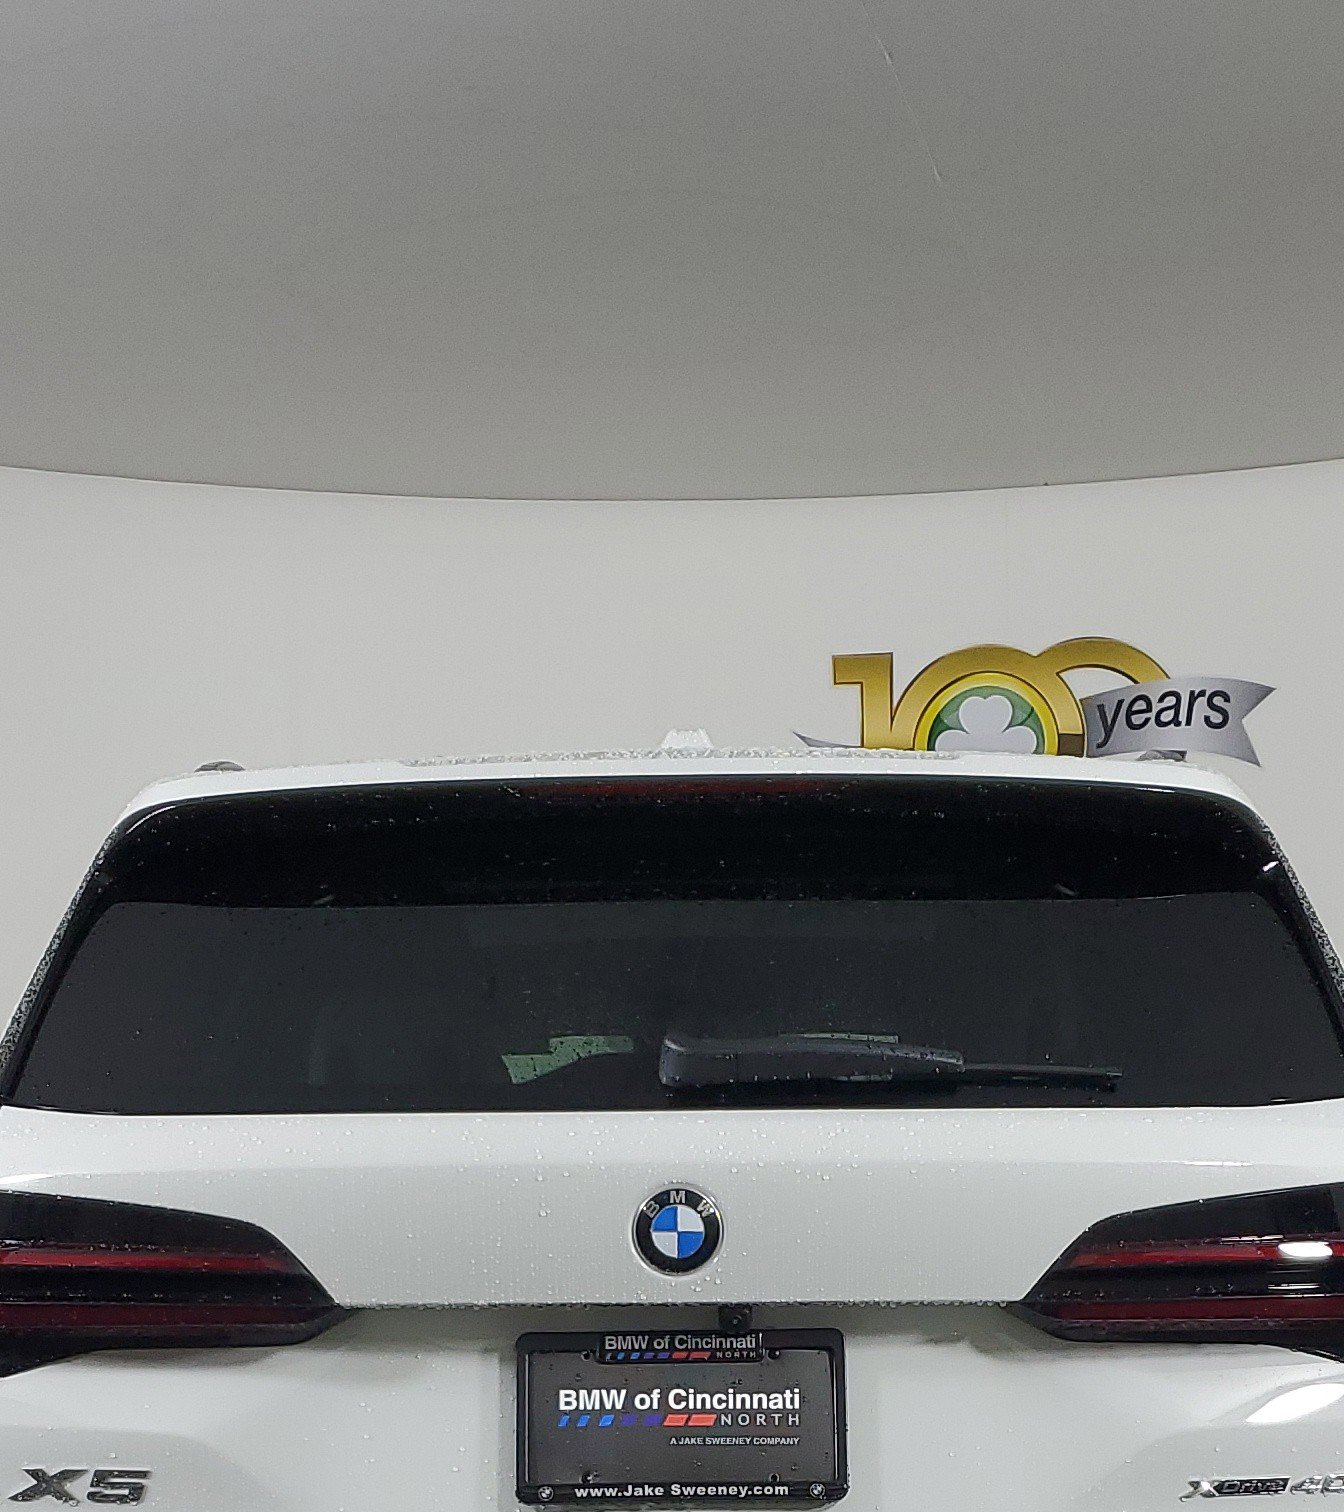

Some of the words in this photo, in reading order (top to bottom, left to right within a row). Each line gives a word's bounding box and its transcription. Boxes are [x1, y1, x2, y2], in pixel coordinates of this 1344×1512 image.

[1096, 686, 1231, 749] years
[643, 1190, 714, 1219] BMW
[605, 1335, 649, 1350] BMW
[653, 1335, 671, 1350] of
[674, 1334, 756, 1349] Cincinnati
[716, 1351, 757, 1359] NORTH
[558, 1389, 627, 1411] BMW
[633, 1388, 661, 1410] of
[667, 1387, 800, 1410] Cincinnati
[720, 1413, 800, 1426] NORTH
[669, 1437, 678, 1445] A
[678, 1437, 704, 1445] JAKE
[705, 1437, 752, 1445] SWEENEY
[753, 1436, 800, 1445] COMPANY
[7, 1468, 153, 1504] X5
[574, 1484, 665, 1497] www.Jake
[670, 1483, 789, 1498] Sweeney.com
